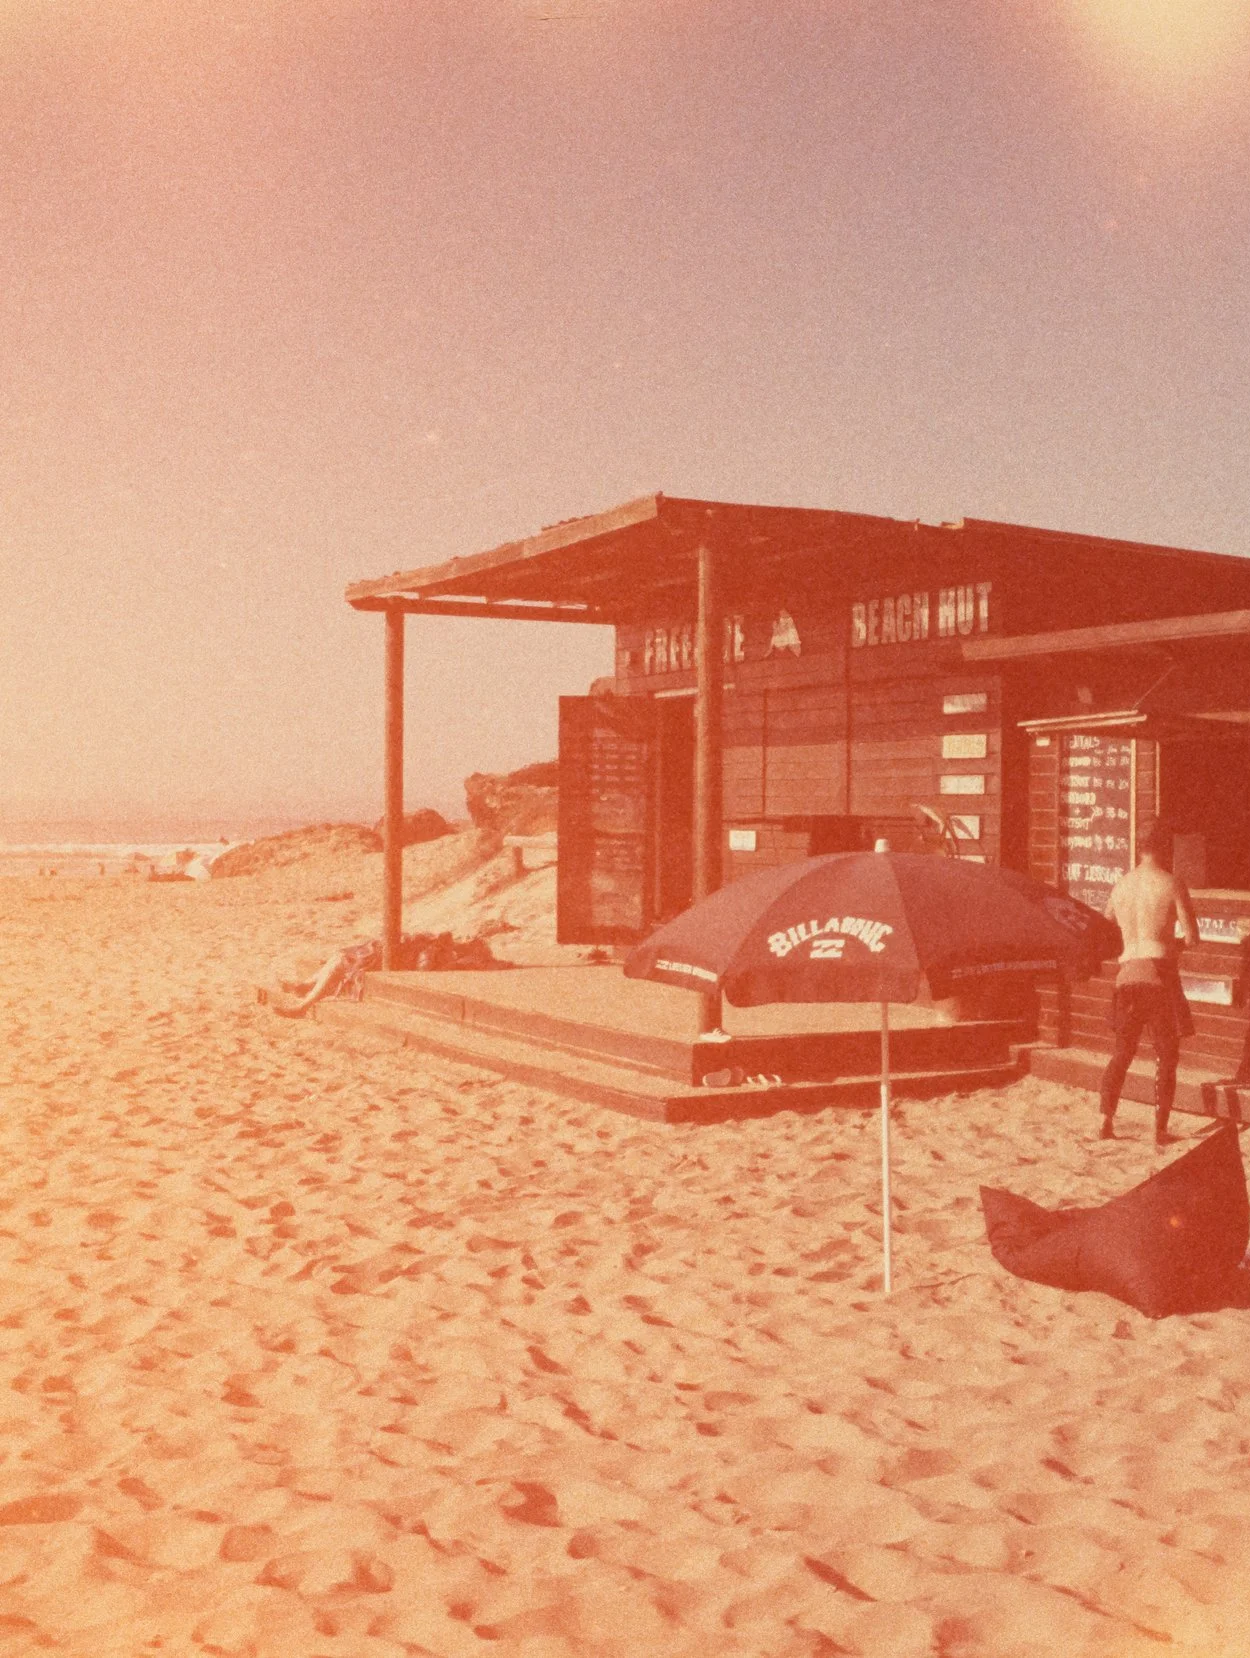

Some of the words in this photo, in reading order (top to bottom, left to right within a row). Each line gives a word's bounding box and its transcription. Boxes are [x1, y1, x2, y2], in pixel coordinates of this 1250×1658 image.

[852, 593, 929, 648] BEACH
[939, 582, 992, 637] HUT
[767, 916, 893, 957] BILLABONG
